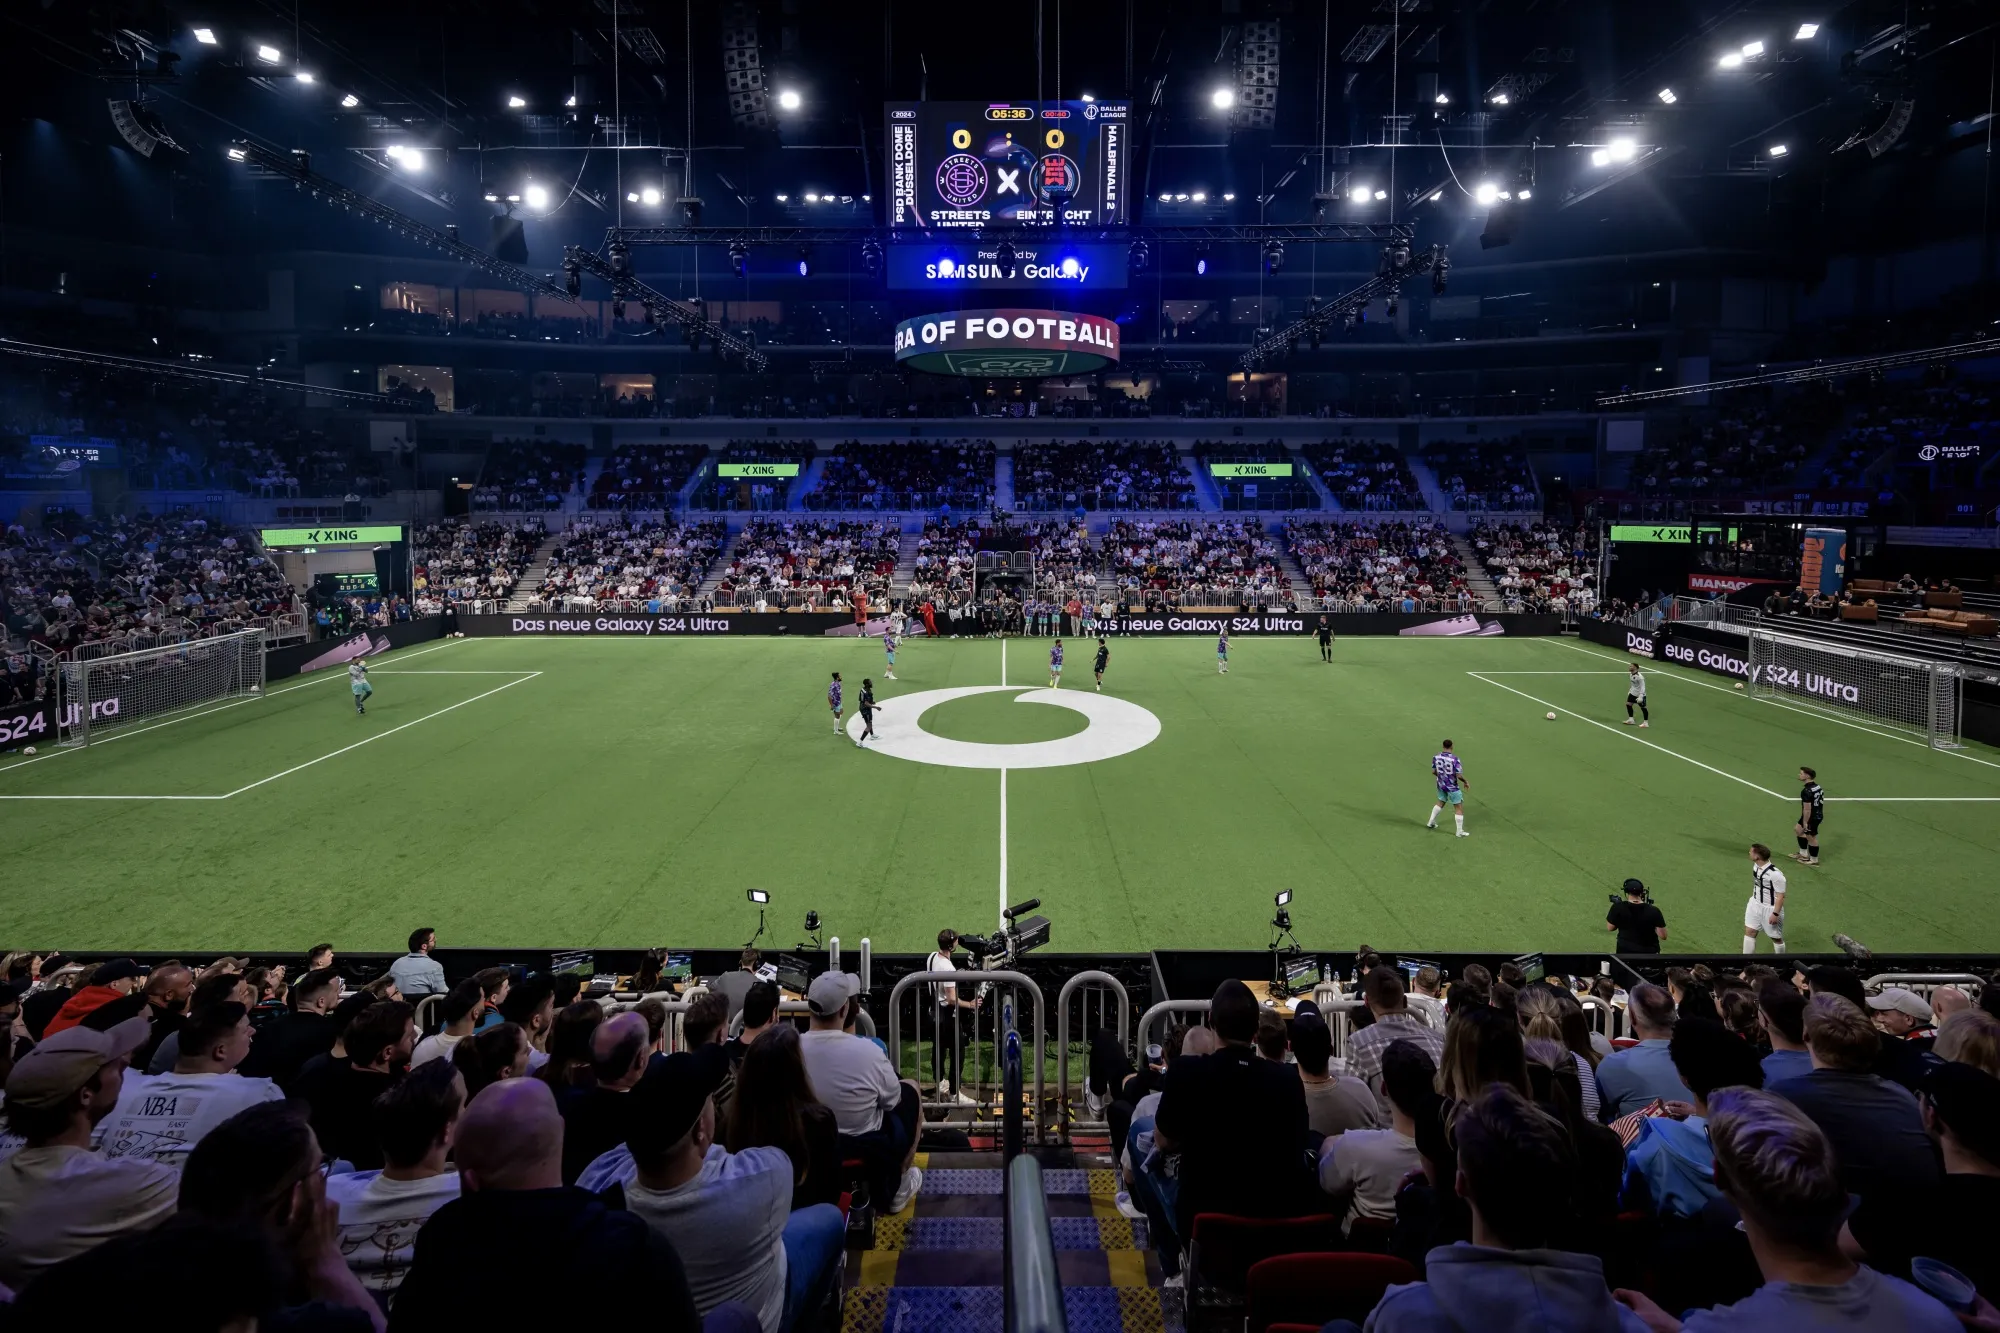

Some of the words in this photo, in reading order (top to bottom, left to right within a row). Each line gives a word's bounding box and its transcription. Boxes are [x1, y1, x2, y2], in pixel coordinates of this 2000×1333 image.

[992, 110, 1026, 118] 05:36
[895, 127, 903, 159] DOME
[952, 129, 971, 149] 0
[1045, 129, 1065, 149] 0
[904, 127, 914, 205] DÜSSELDORF
[944, 157, 979, 169] STREETS
[1107, 125, 1117, 200] HALBFINALE
[896, 162, 904, 196] BANK
[947, 193, 977, 203] UNITED
[896, 199, 904, 222] PSD
[931, 211, 990, 220] STREETS
[1025, 250, 1037, 261] by
[921, 320, 956, 344] OF
[965, 317, 1114, 348] FOOTBALL
[752, 466, 774, 475] XING
[1244, 465, 1267, 475] XING
[1957, 504, 1974, 512] 001
[324, 529, 358, 541] XING
[1691, 577, 1753, 591] MANAG
[512, 618, 545, 631] Das
[549, 620, 591, 631] neue
[595, 617, 654, 635] Galaxy
[658, 617, 686, 631] S24
[690, 618, 729, 631] Ultra
[1168, 617, 1227, 634] Galaxy
[1232, 617, 1260, 631] S24
[1264, 618, 1303, 631] Ultra
[1627, 632, 1652, 651] Das
[1665, 643, 1694, 662] eue
[1698, 649, 1761, 683] Galaxy
[1766, 664, 1800, 688] S24
[1806, 672, 1858, 702] Ultra
[0, 711, 47, 743] S24
[55, 697, 119, 728] Ulra
[137, 1096, 178, 1116] NBA
